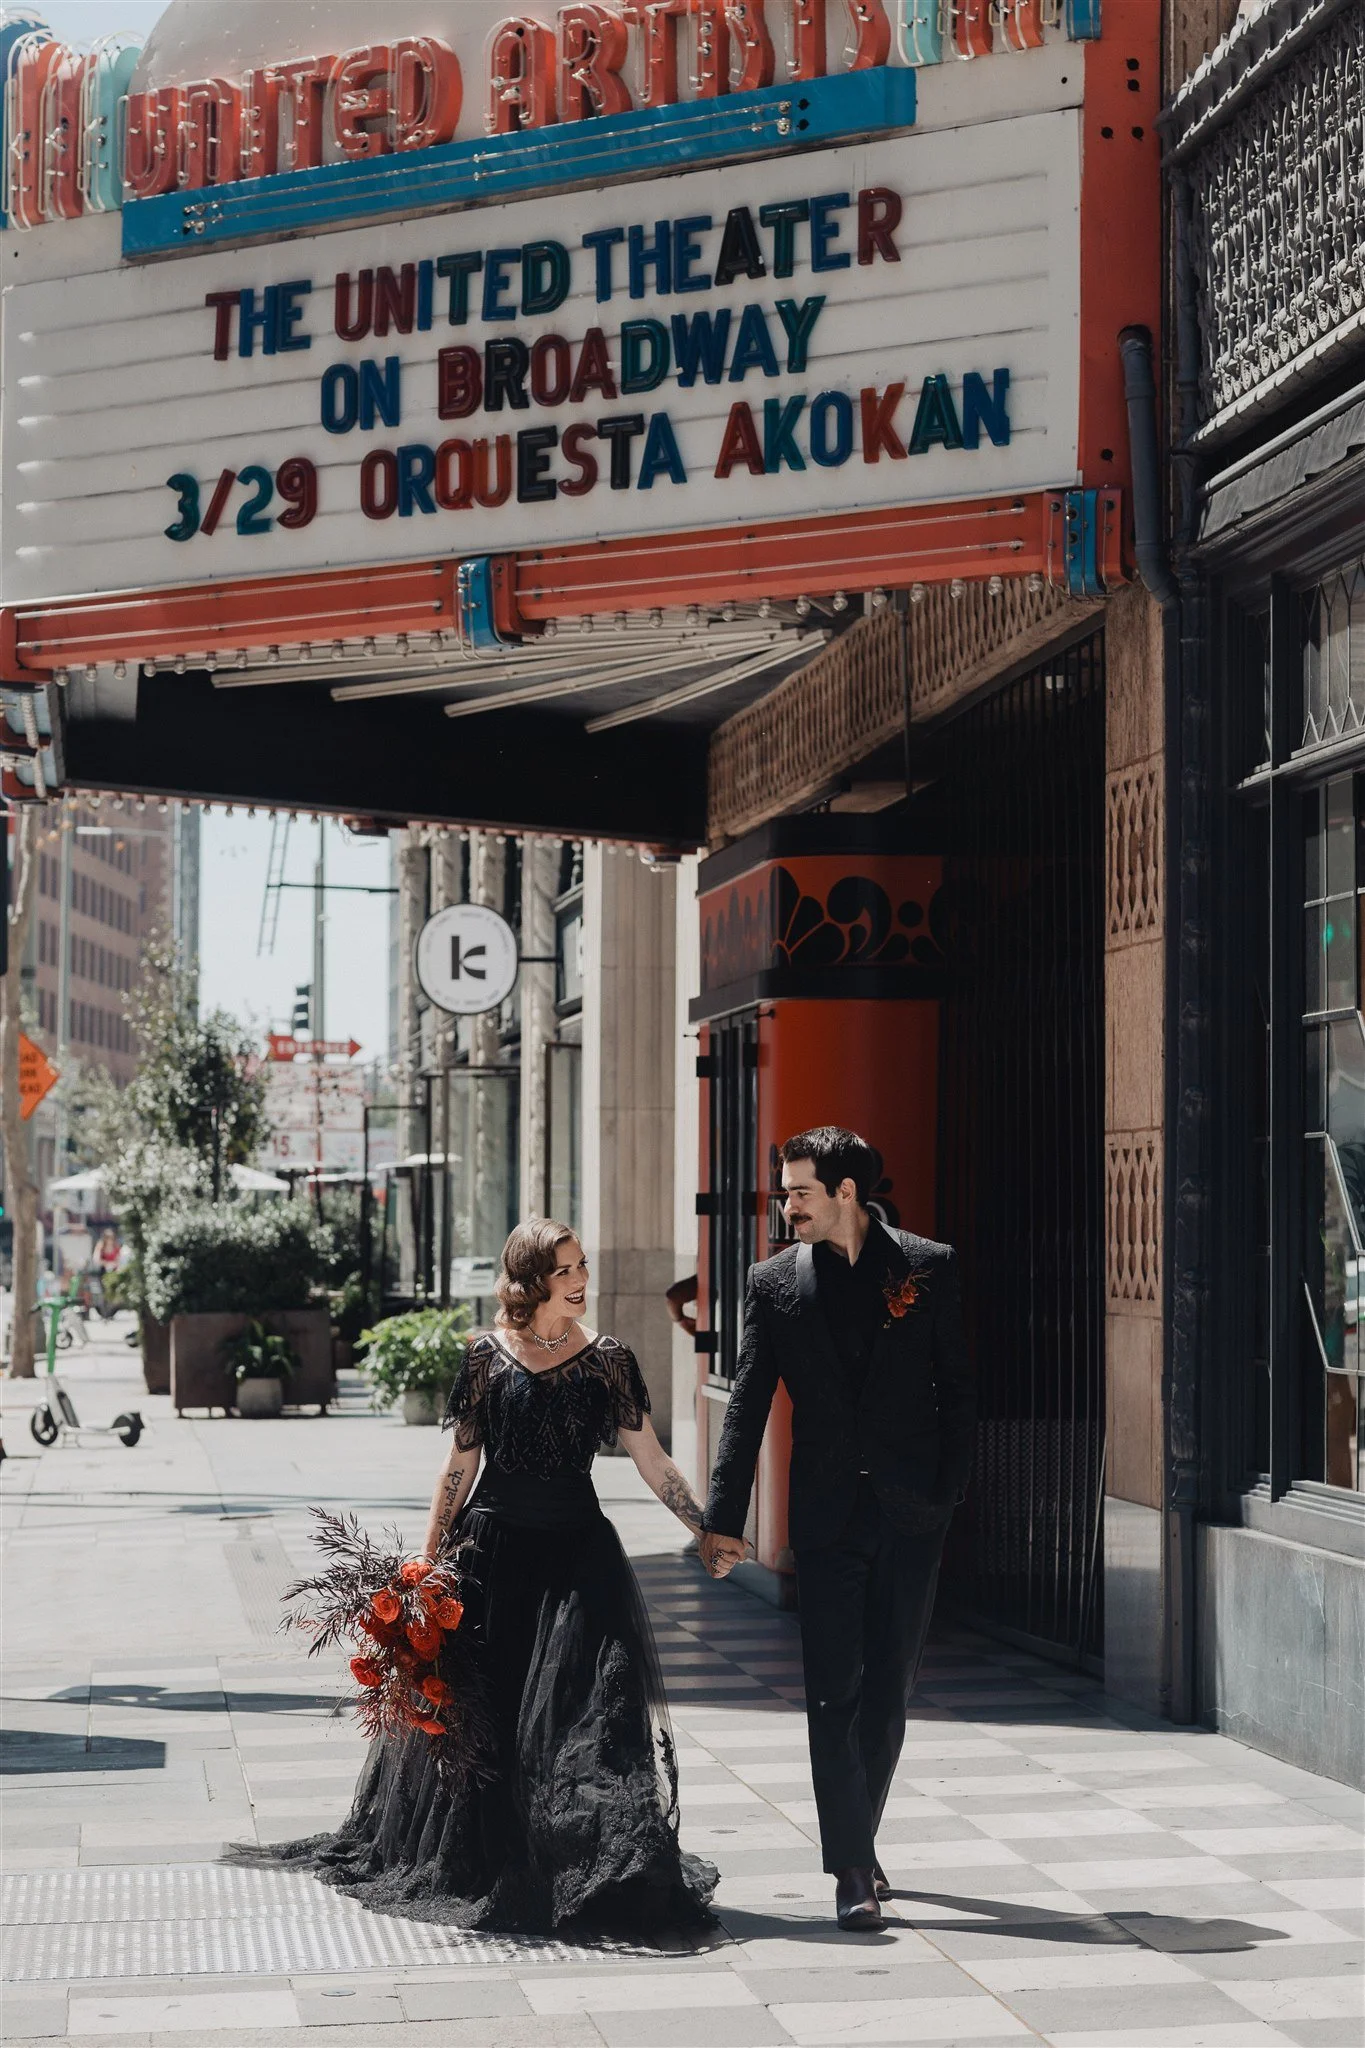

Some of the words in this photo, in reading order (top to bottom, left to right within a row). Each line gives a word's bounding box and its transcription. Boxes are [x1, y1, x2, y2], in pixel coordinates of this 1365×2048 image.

[117, 37, 463, 197] UNITED
[205, 280, 312, 361] THE
[334, 240, 571, 342] UNITED
[582, 187, 902, 303] THEATER
[320, 356, 400, 434] ON
[438, 296, 827, 420] BROADWAY
[164, 457, 318, 542] 3/29
[360, 412, 688, 520] ORQUESTA
[714, 368, 1011, 479] AKOKAN
[437, 1508, 452, 1527] the
